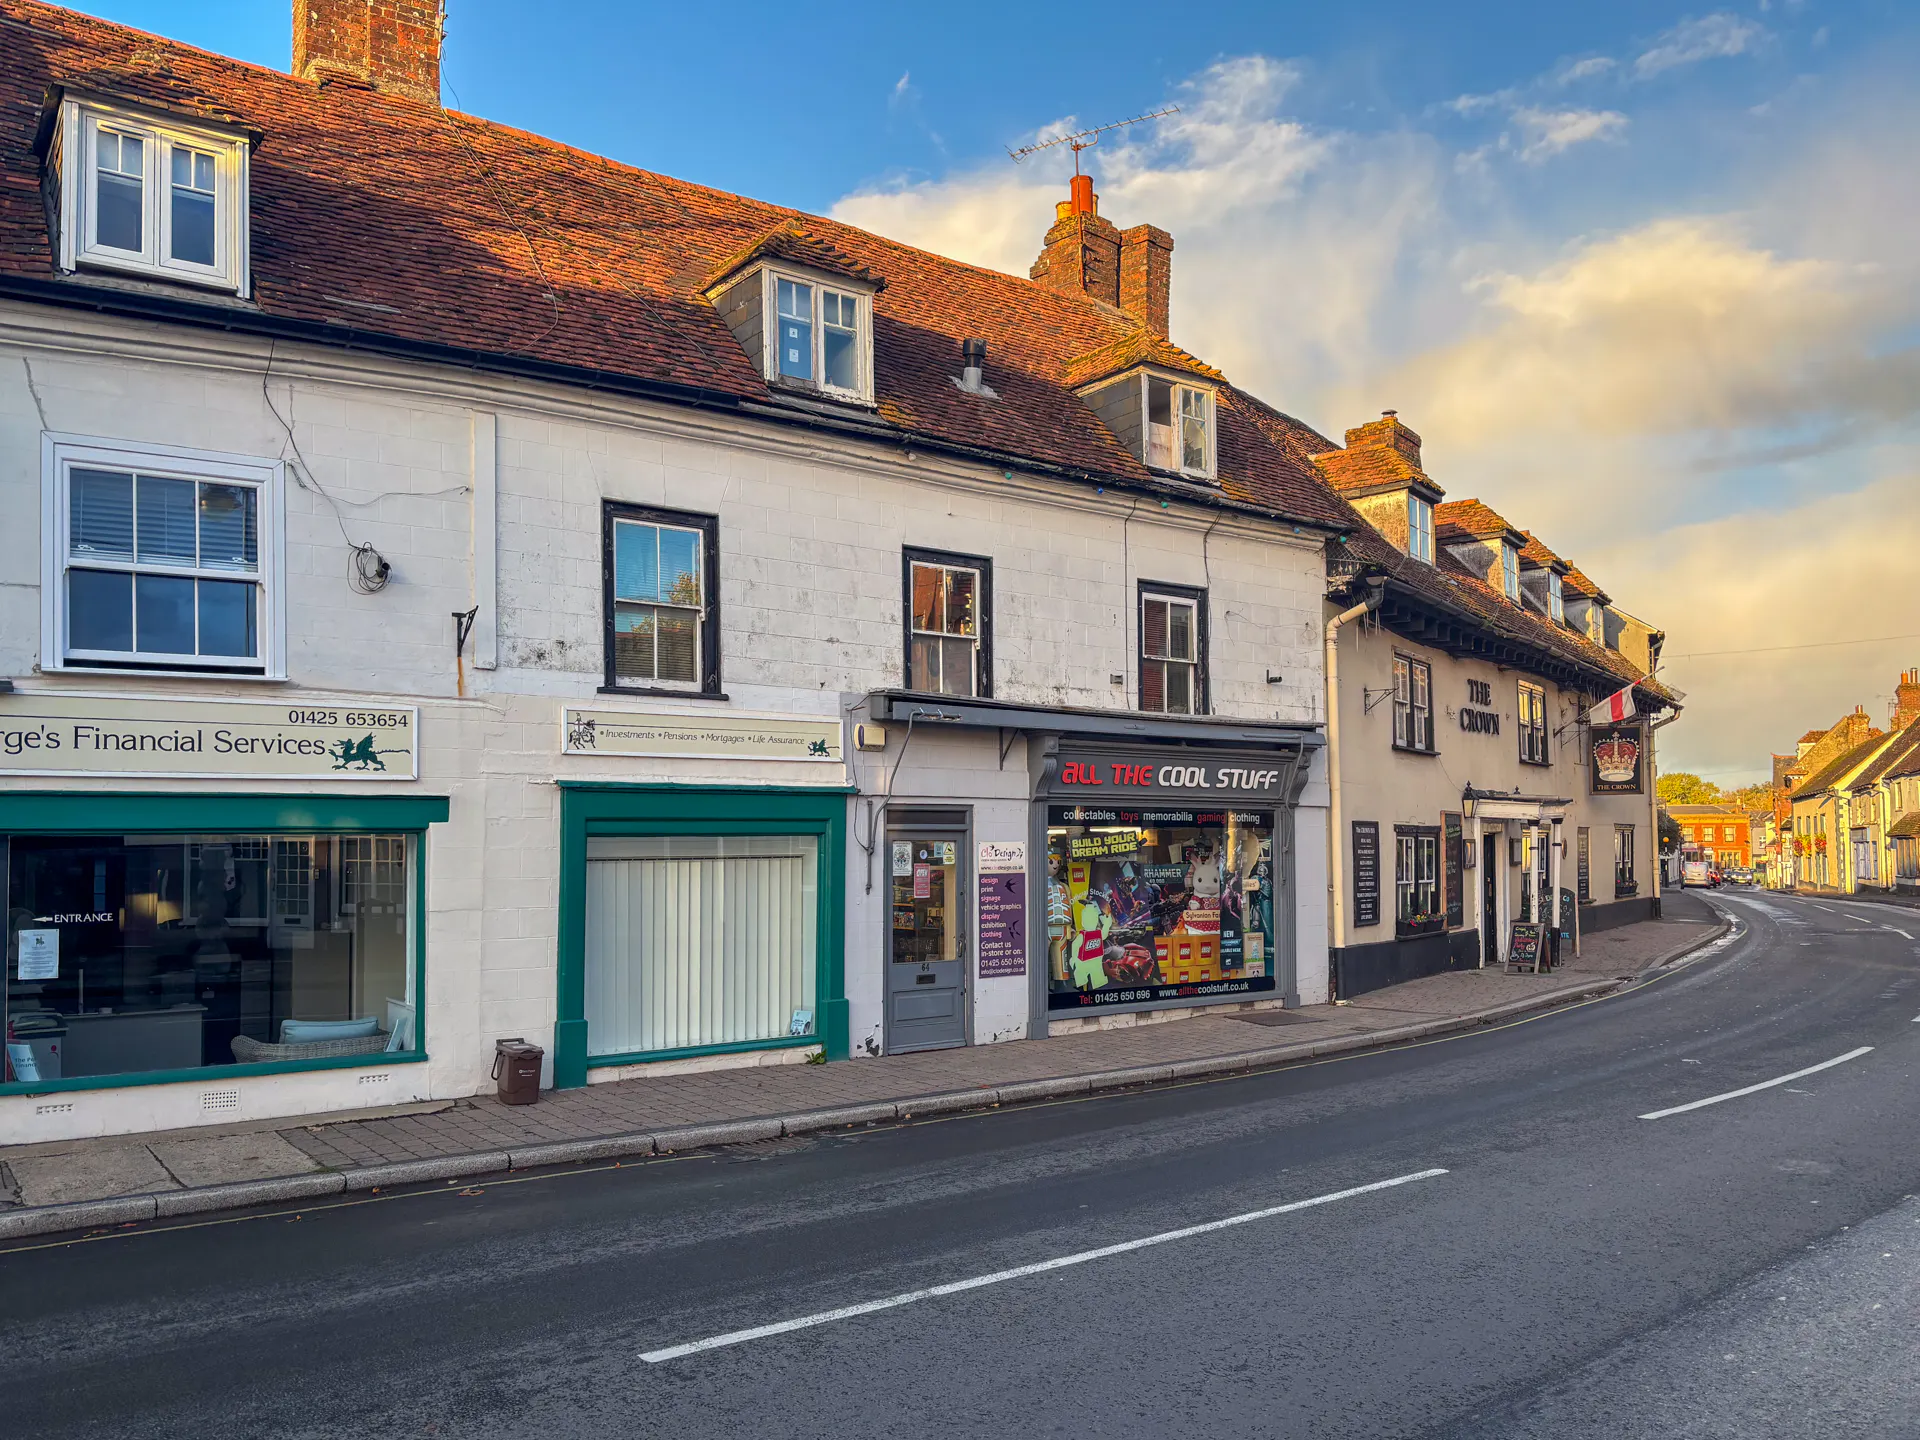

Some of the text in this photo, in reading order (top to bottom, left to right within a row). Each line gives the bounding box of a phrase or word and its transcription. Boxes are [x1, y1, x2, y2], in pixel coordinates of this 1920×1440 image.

[1467, 679, 1491, 706] THE
[289, 709, 408, 728] 01425 653654
[1460, 707, 1500, 735] CROWN
[73, 725, 203, 753] Financial
[214, 730, 326, 755] Services
[605, 729, 805, 745] Investments Pensions Mortgages Life Assurance
[1111, 763, 1153, 786] THE
[1158, 765, 1211, 788] COOL
[1215, 768, 1279, 790] STUFF
[1063, 810, 1260, 825] collectables toys memorabilia gaming clothing
[1072, 832, 1136, 848] BUILD YOUR
[994, 848, 1016, 861] Design
[1072, 841, 1138, 858] DREAM RIDE
[980, 877, 999, 885] design
[980, 886, 994, 894] print
[980, 895, 1001, 903] signage
[980, 903, 1022, 912] vehicle graphics
[54, 912, 114, 923] ENTRANCE
[980, 913, 1000, 921] display
[1185, 912, 1211, 920] Sylvanian
[980, 921, 1007, 929] exhibition
[980, 930, 1002, 939] clothing
[980, 941, 1003, 949] Contact
[1085, 939, 1101, 951] LEGO
[980, 949, 1003, 957] in-store
[921, 963, 930, 972] 64
[1079, 981, 1249, 1005] Tel: 01425 650 696 www.allthecoolstuff.co.uk
